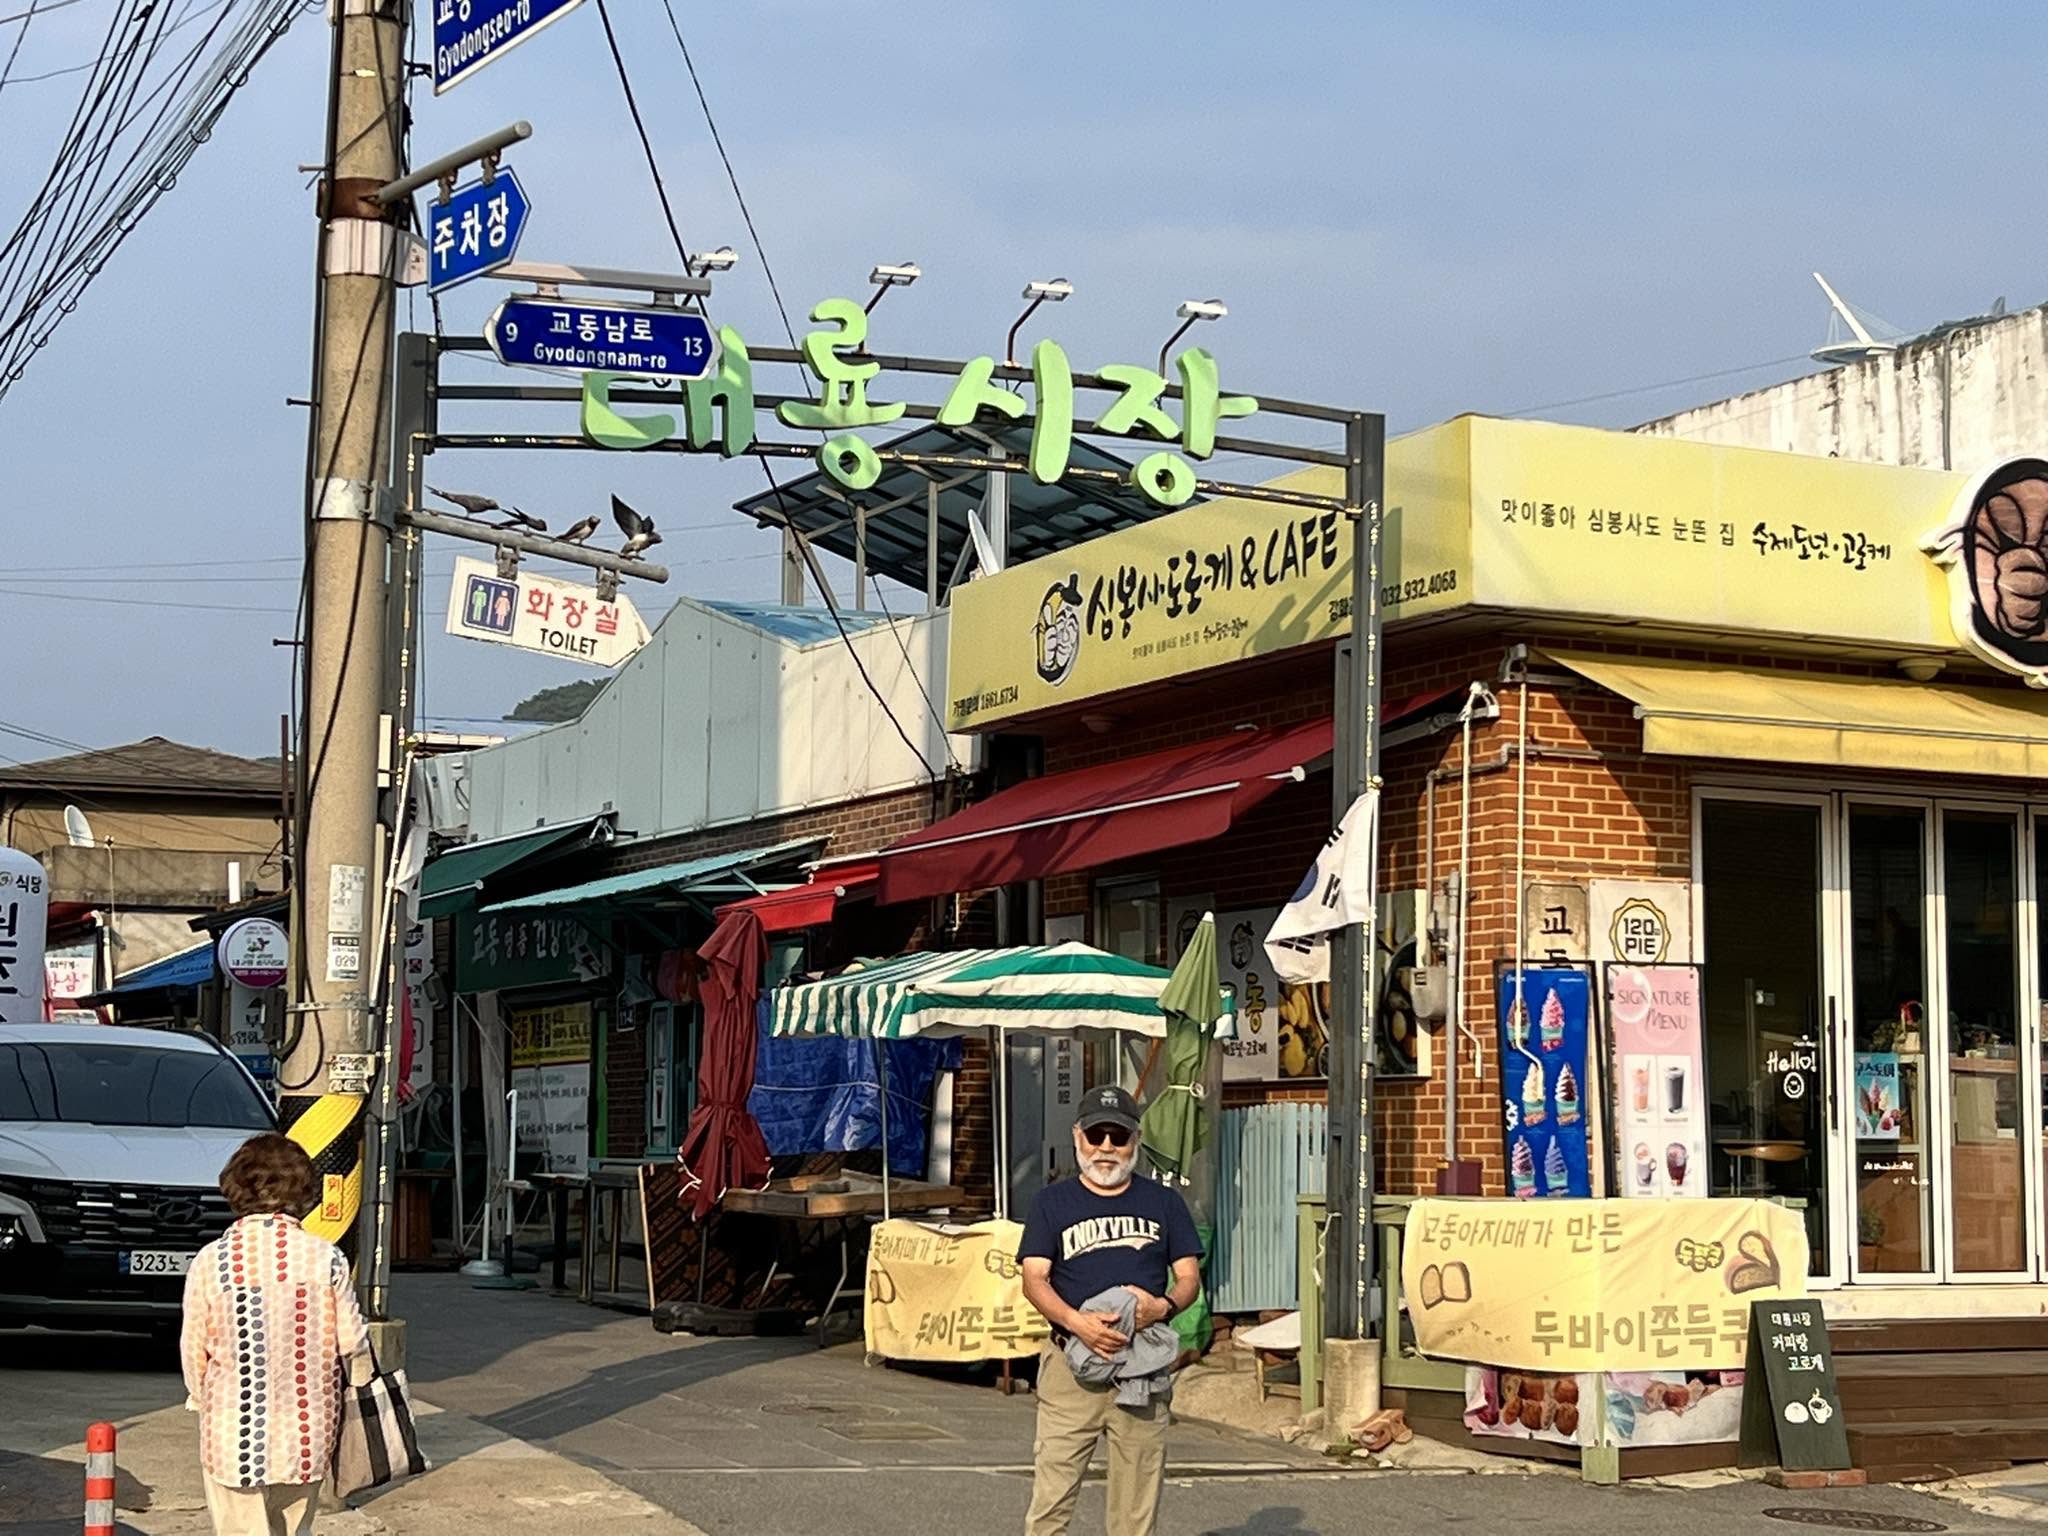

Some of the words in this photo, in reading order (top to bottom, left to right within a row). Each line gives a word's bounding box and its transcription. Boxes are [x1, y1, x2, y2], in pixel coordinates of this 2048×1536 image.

[438, 0, 530, 77] Gyodongseo-ro
[433, 191, 510, 271] 주차장
[505, 322, 519, 343] 9
[533, 342, 667, 370] Gyodongnam-ro
[682, 337, 703, 357] 13
[549, 311, 654, 344] 교동남로
[1501, 499, 1576, 530] 맛이좋아
[1588, 509, 1661, 537] 심봉사도
[1672, 517, 1708, 544] 눈뜬
[1719, 523, 1736, 547] 집
[525, 588, 619, 636] 화장실
[540, 628, 599, 656] TOILET
[16, 875, 42, 894] 식당
[1625, 937, 1655, 954] PIE
[1618, 990, 1692, 1006] SIGNATURE
[1645, 1008, 1688, 1032] MENU
[1062, 1216, 1160, 1260] KNOXVILLE
[1567, 1213, 1623, 1253] 만든
[1531, 1304, 1748, 1358] 두바이쫀득쿠
[1771, 1333, 1808, 1352] 커피랑
